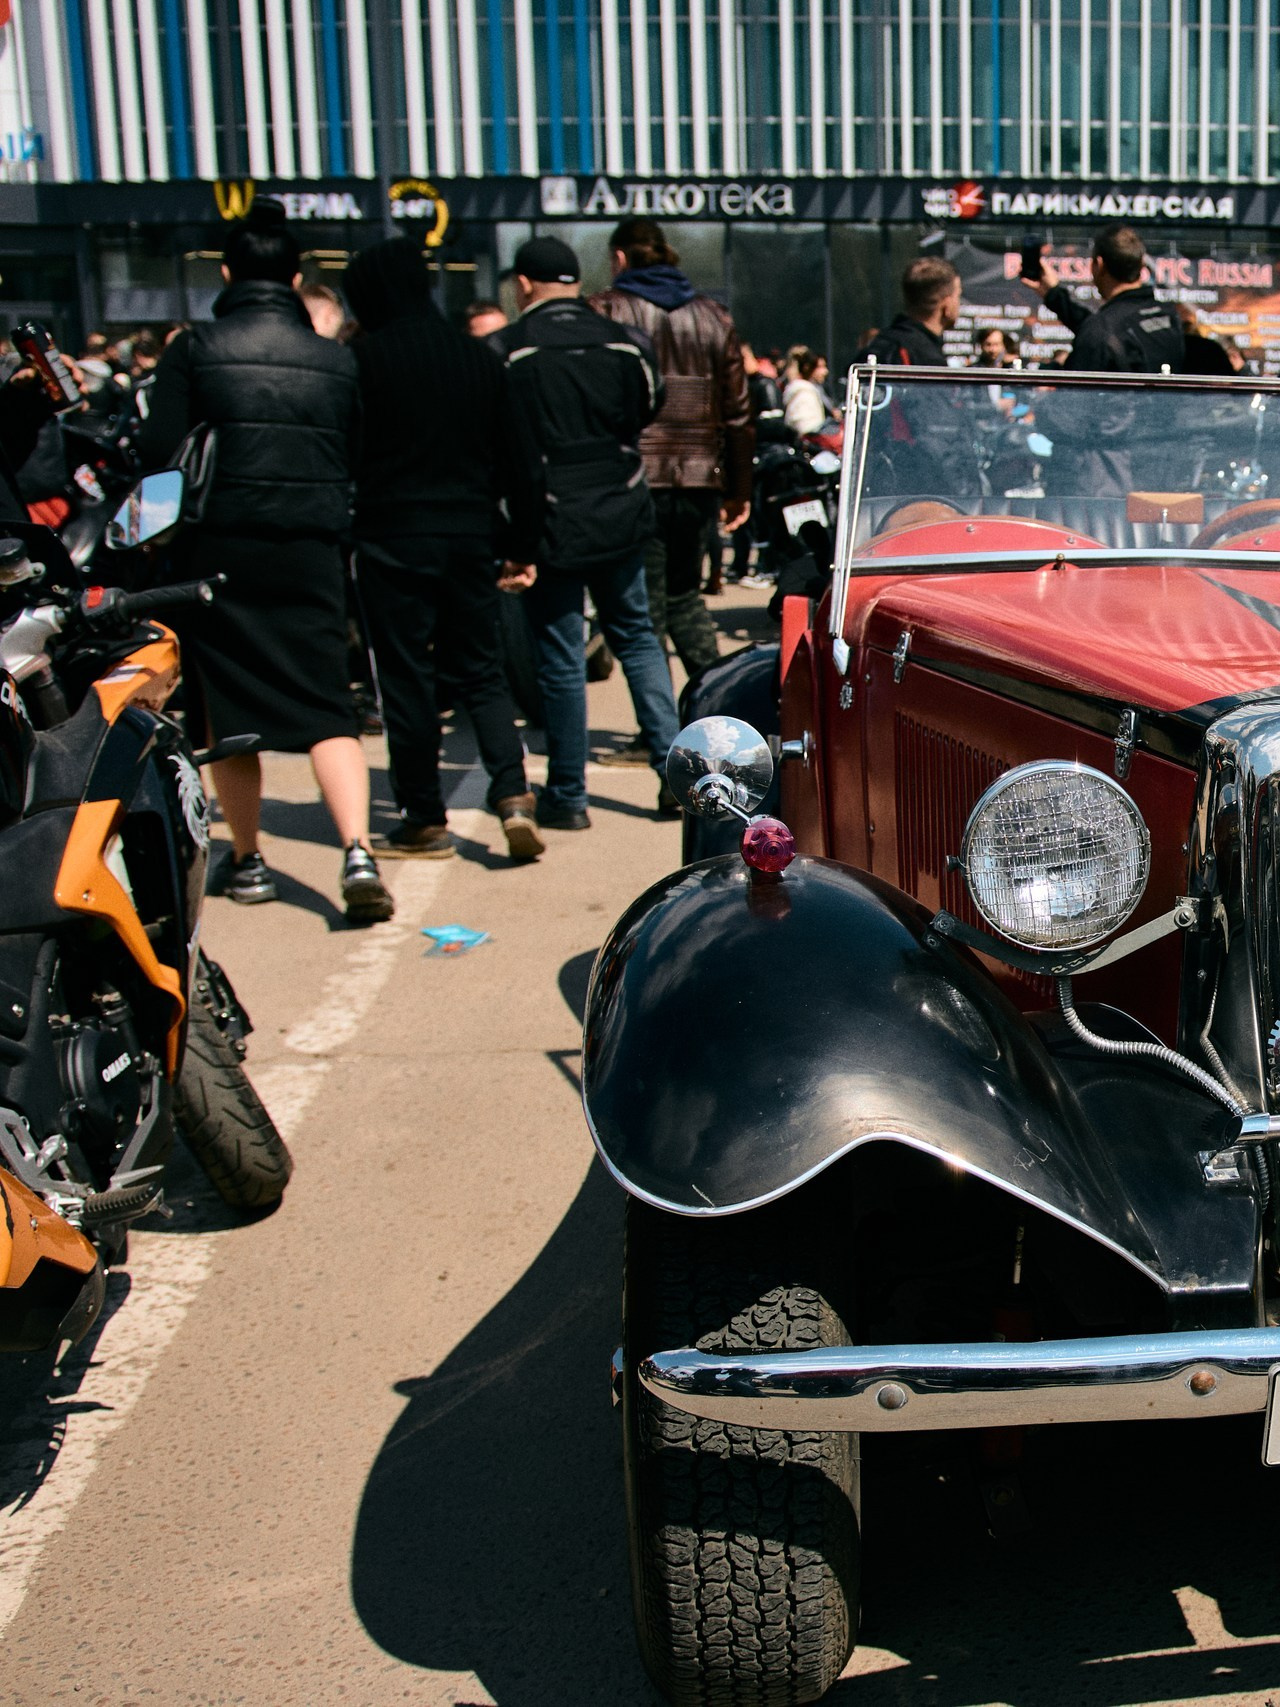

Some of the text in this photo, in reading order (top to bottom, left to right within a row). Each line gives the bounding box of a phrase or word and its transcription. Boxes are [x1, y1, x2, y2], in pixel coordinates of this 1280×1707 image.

[583, 177, 795, 216] Алкотека
[991, 192, 1234, 219] ПАРИКМАХЕРСКАЯ
[1155, 258, 1193, 286] MC
